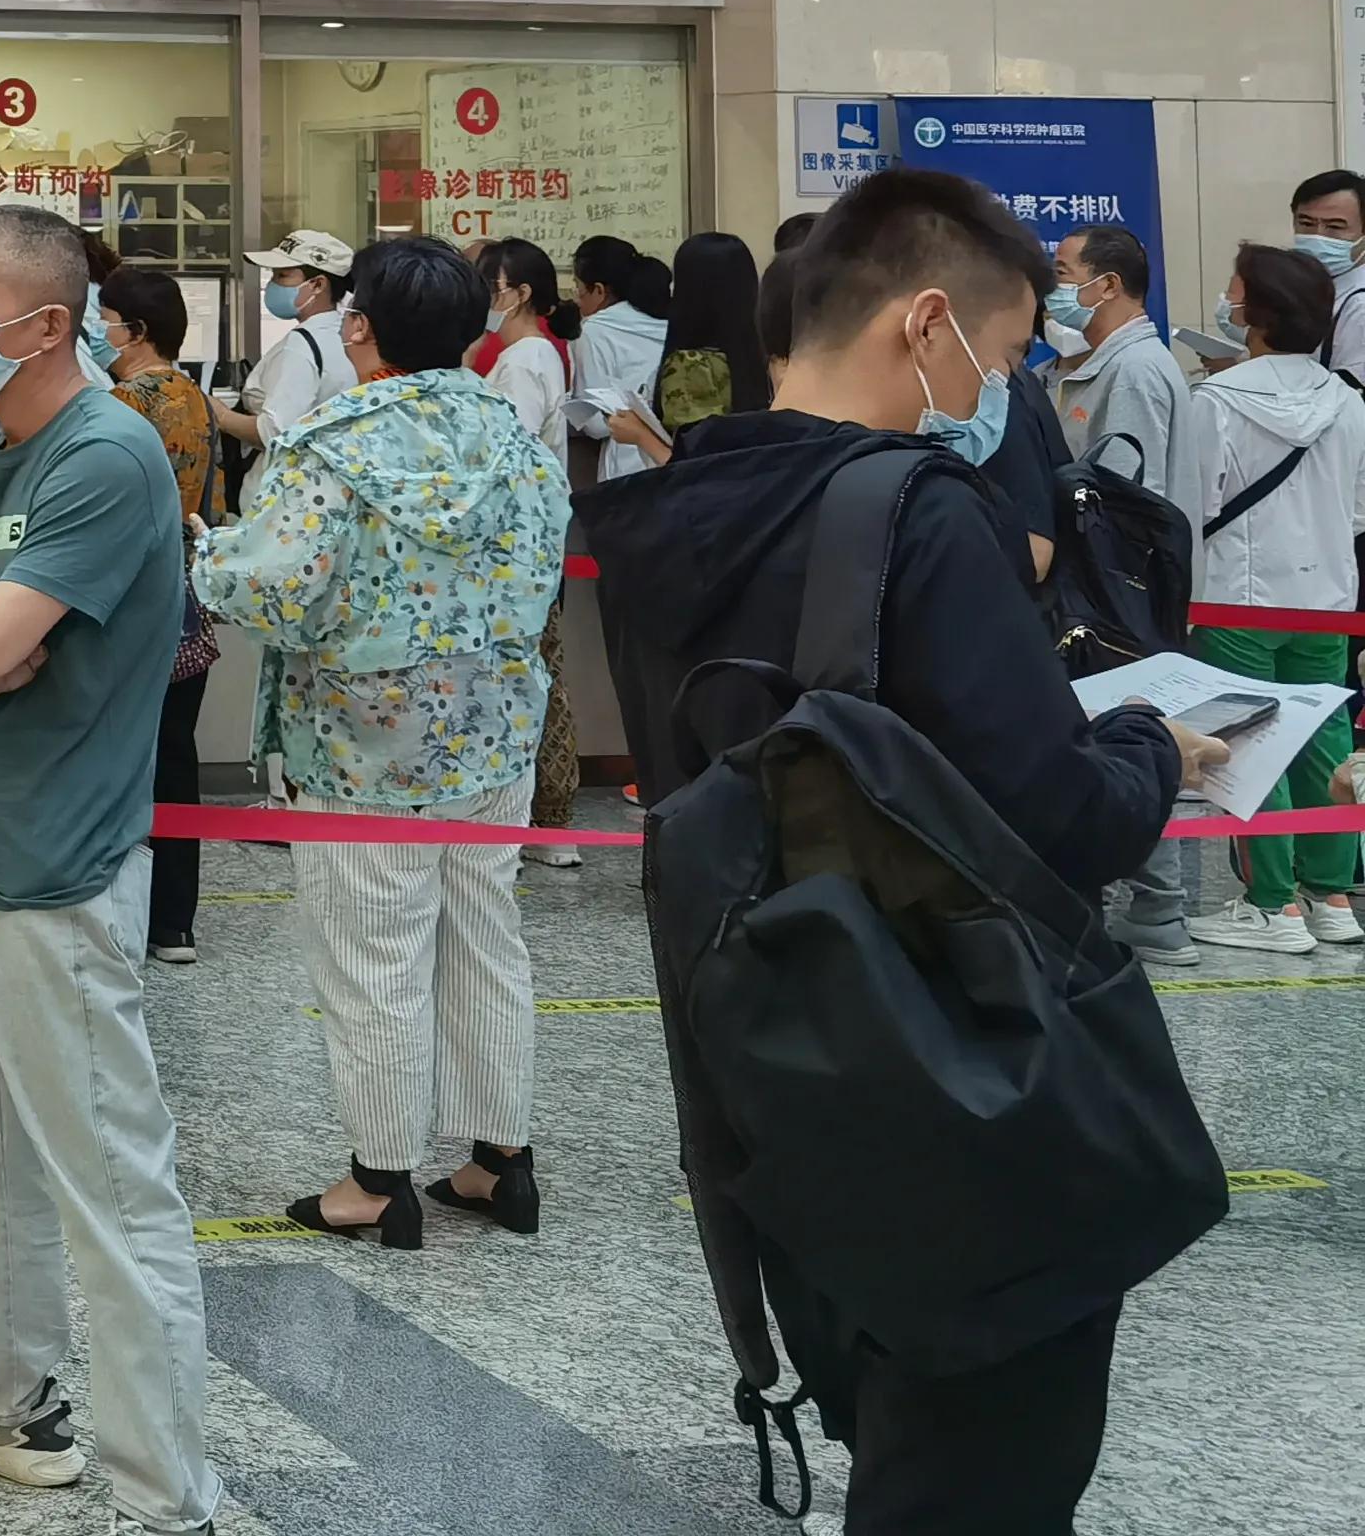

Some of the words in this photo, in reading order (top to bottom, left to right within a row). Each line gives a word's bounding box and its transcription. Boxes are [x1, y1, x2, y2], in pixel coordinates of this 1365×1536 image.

[4, 86, 25, 118] 3
[467, 96, 489, 127] 4
[952, 122, 1086, 137] 中国医学科学院肿瘤医院
[803, 153, 901, 171] 图像采集区
[991, 194, 1125, 222] 费不排队
[452, 210, 493, 235] CT
